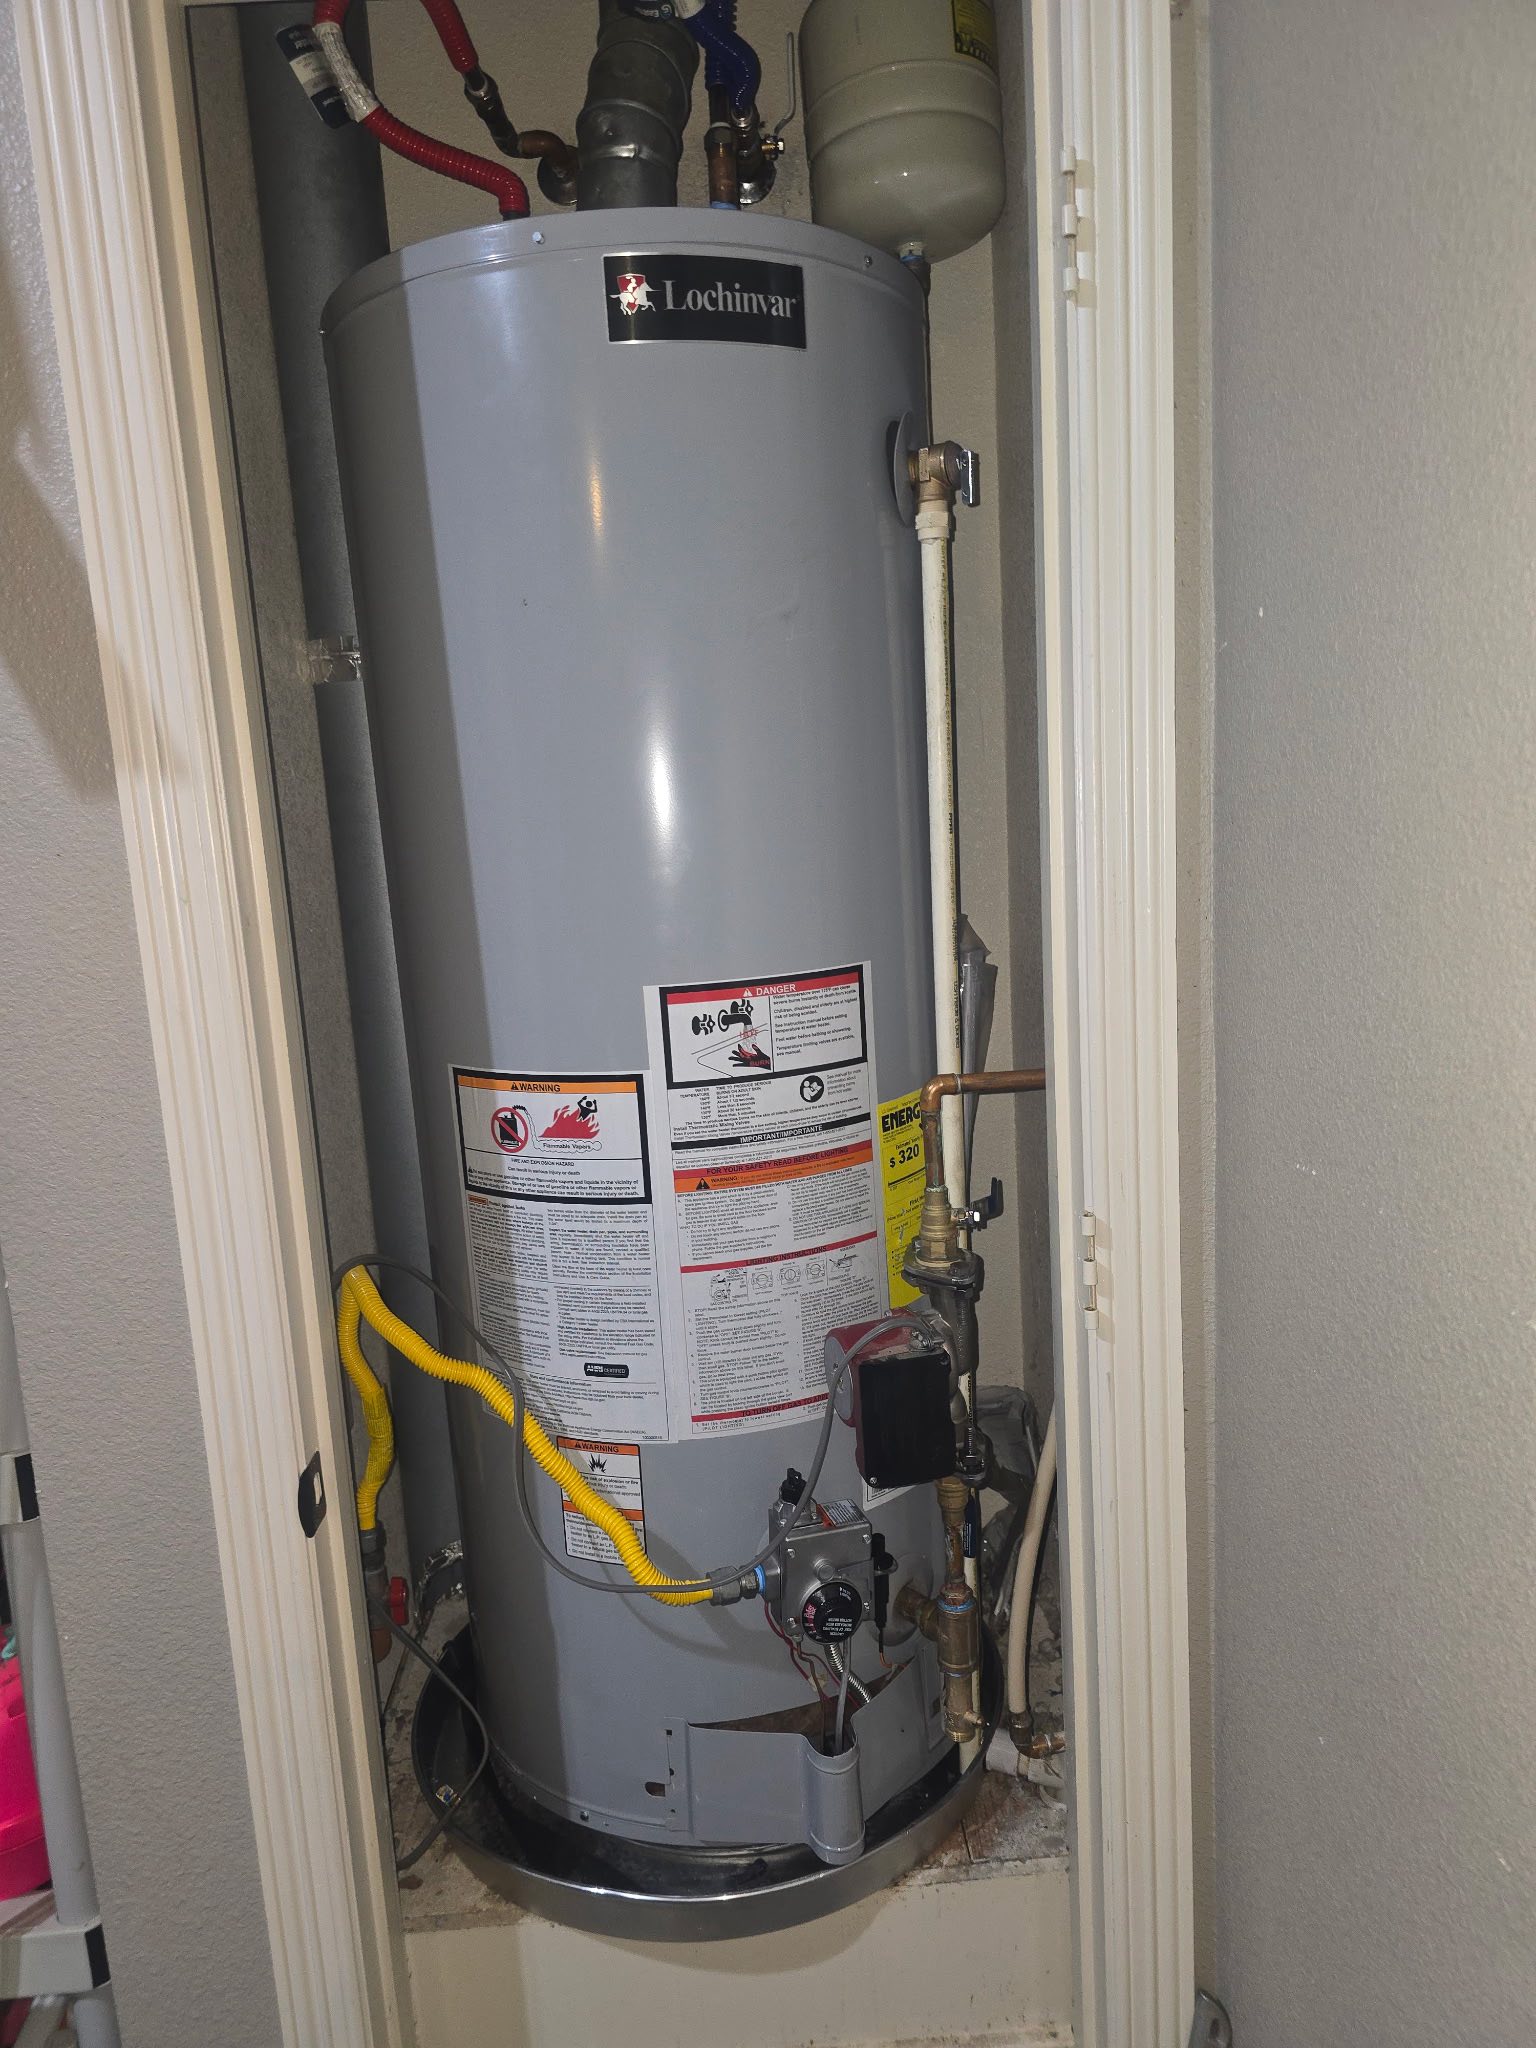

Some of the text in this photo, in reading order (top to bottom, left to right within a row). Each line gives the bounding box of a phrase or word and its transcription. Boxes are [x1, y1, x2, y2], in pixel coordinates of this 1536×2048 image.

[662, 280, 796, 318] Lochinvar
[756, 984, 796, 996] DANGER
[520, 1083, 560, 1092] WARNING
[746, 1161, 772, 1170] SAFETY
[774, 1159, 791, 1167] READ
[794, 1155, 819, 1163] BEFORE
[821, 1146, 848, 1158] LIGHTING
[899, 1144, 919, 1164] 320
[788, 1401, 800, 1409] GAS
[580, 1444, 618, 1452] WARNING
